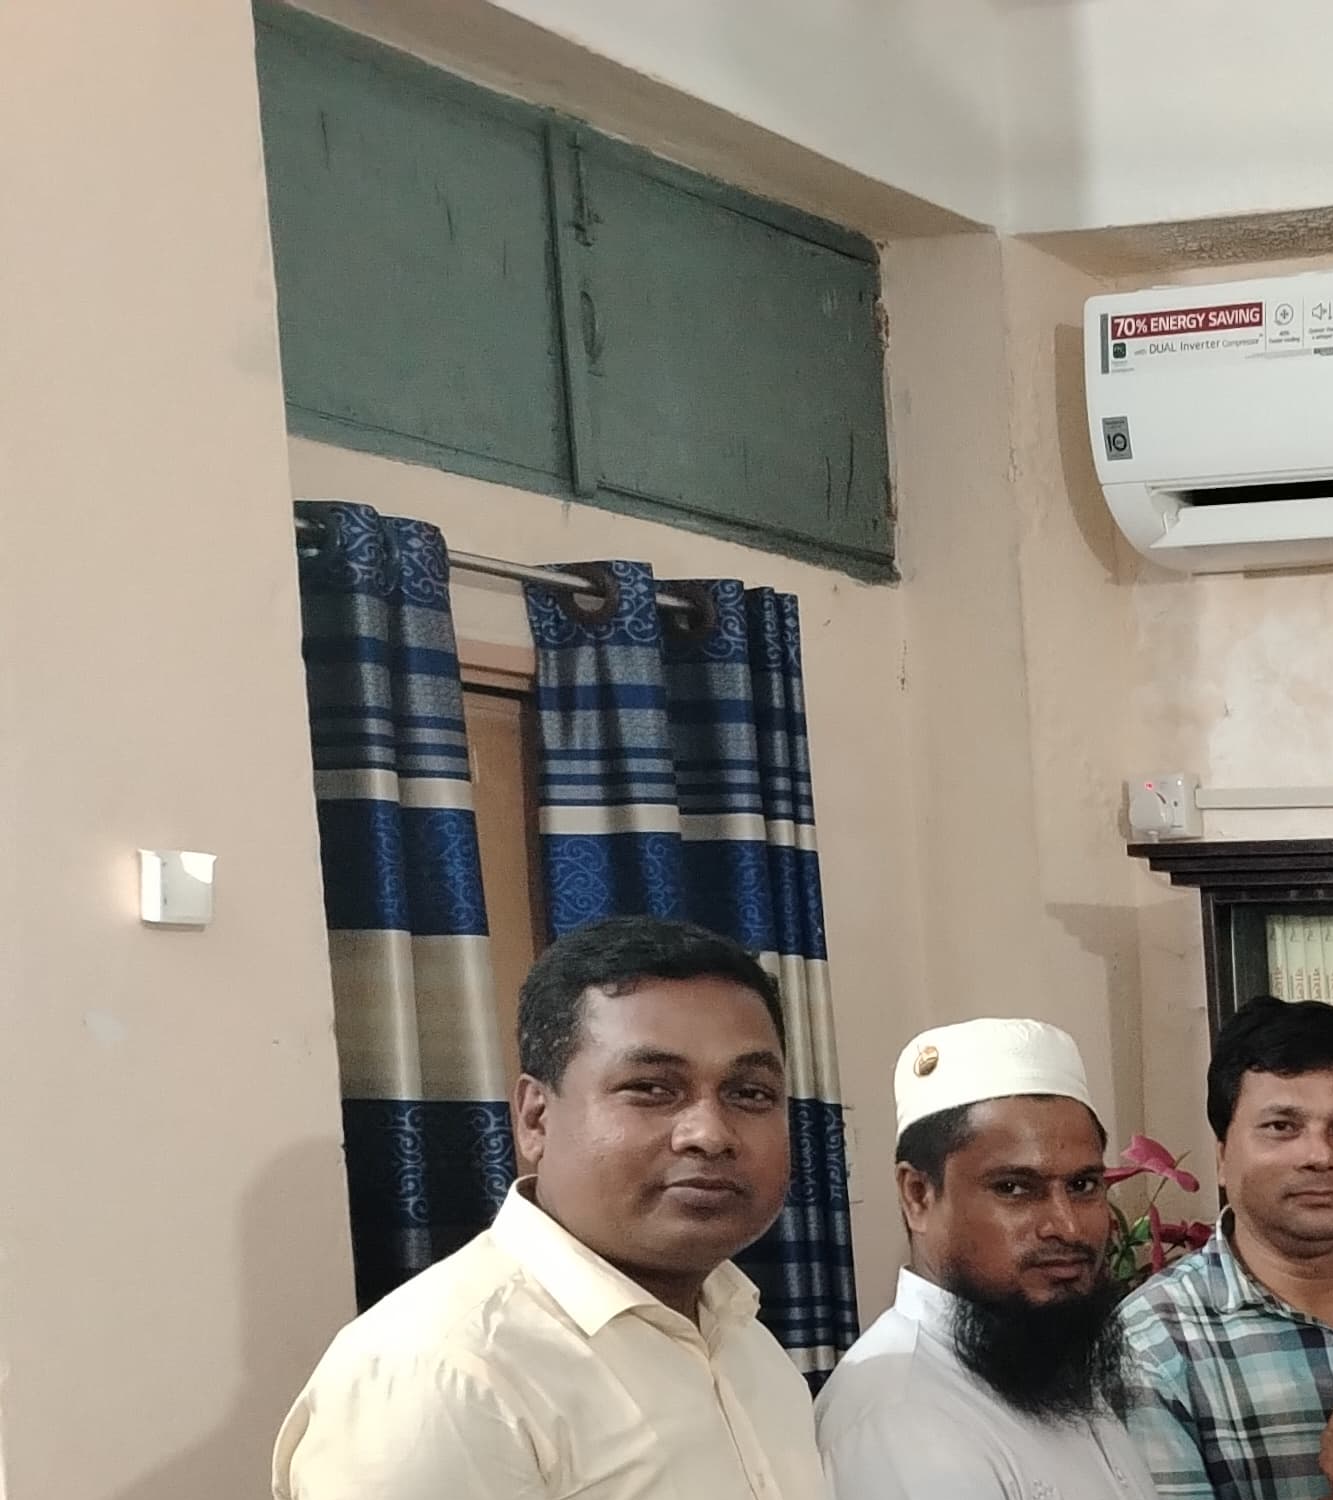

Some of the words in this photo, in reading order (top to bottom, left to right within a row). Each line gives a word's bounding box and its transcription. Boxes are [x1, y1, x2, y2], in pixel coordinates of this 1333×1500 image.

[1113, 317, 1148, 337] 70%
[1150, 312, 1206, 332] ENERGY
[1208, 307, 1260, 327] SAVING
[1149, 342, 1177, 354] DUAL
[1180, 339, 1220, 352] Inverter
